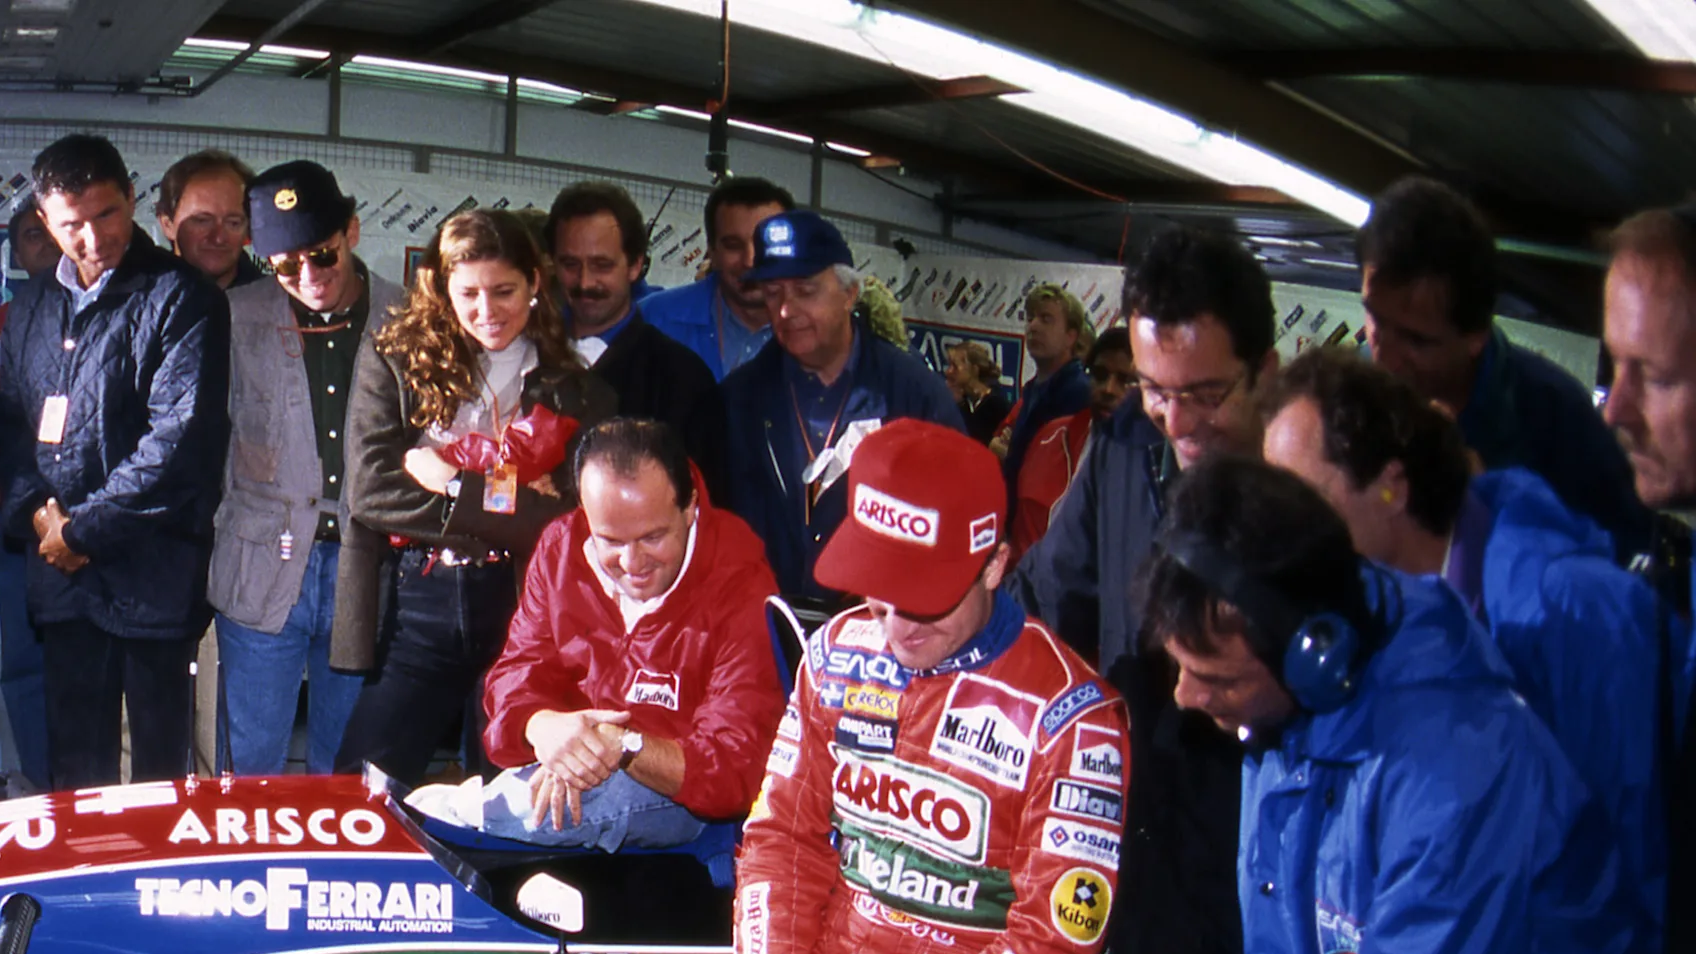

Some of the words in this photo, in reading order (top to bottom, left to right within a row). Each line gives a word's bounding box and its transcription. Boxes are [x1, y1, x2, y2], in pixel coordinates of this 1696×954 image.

[857, 497, 932, 538] ARISCO
[1042, 684, 1100, 730] sparco
[939, 714, 1025, 768] Marlboro
[836, 761, 971, 841] ARISCO
[1057, 782, 1120, 820] Diav
[168, 807, 386, 847] ARISCO
[307, 917, 376, 933] INDUSTRIAL
[378, 920, 453, 934] AUTOMATION
[518, 900, 561, 923] arlboro
